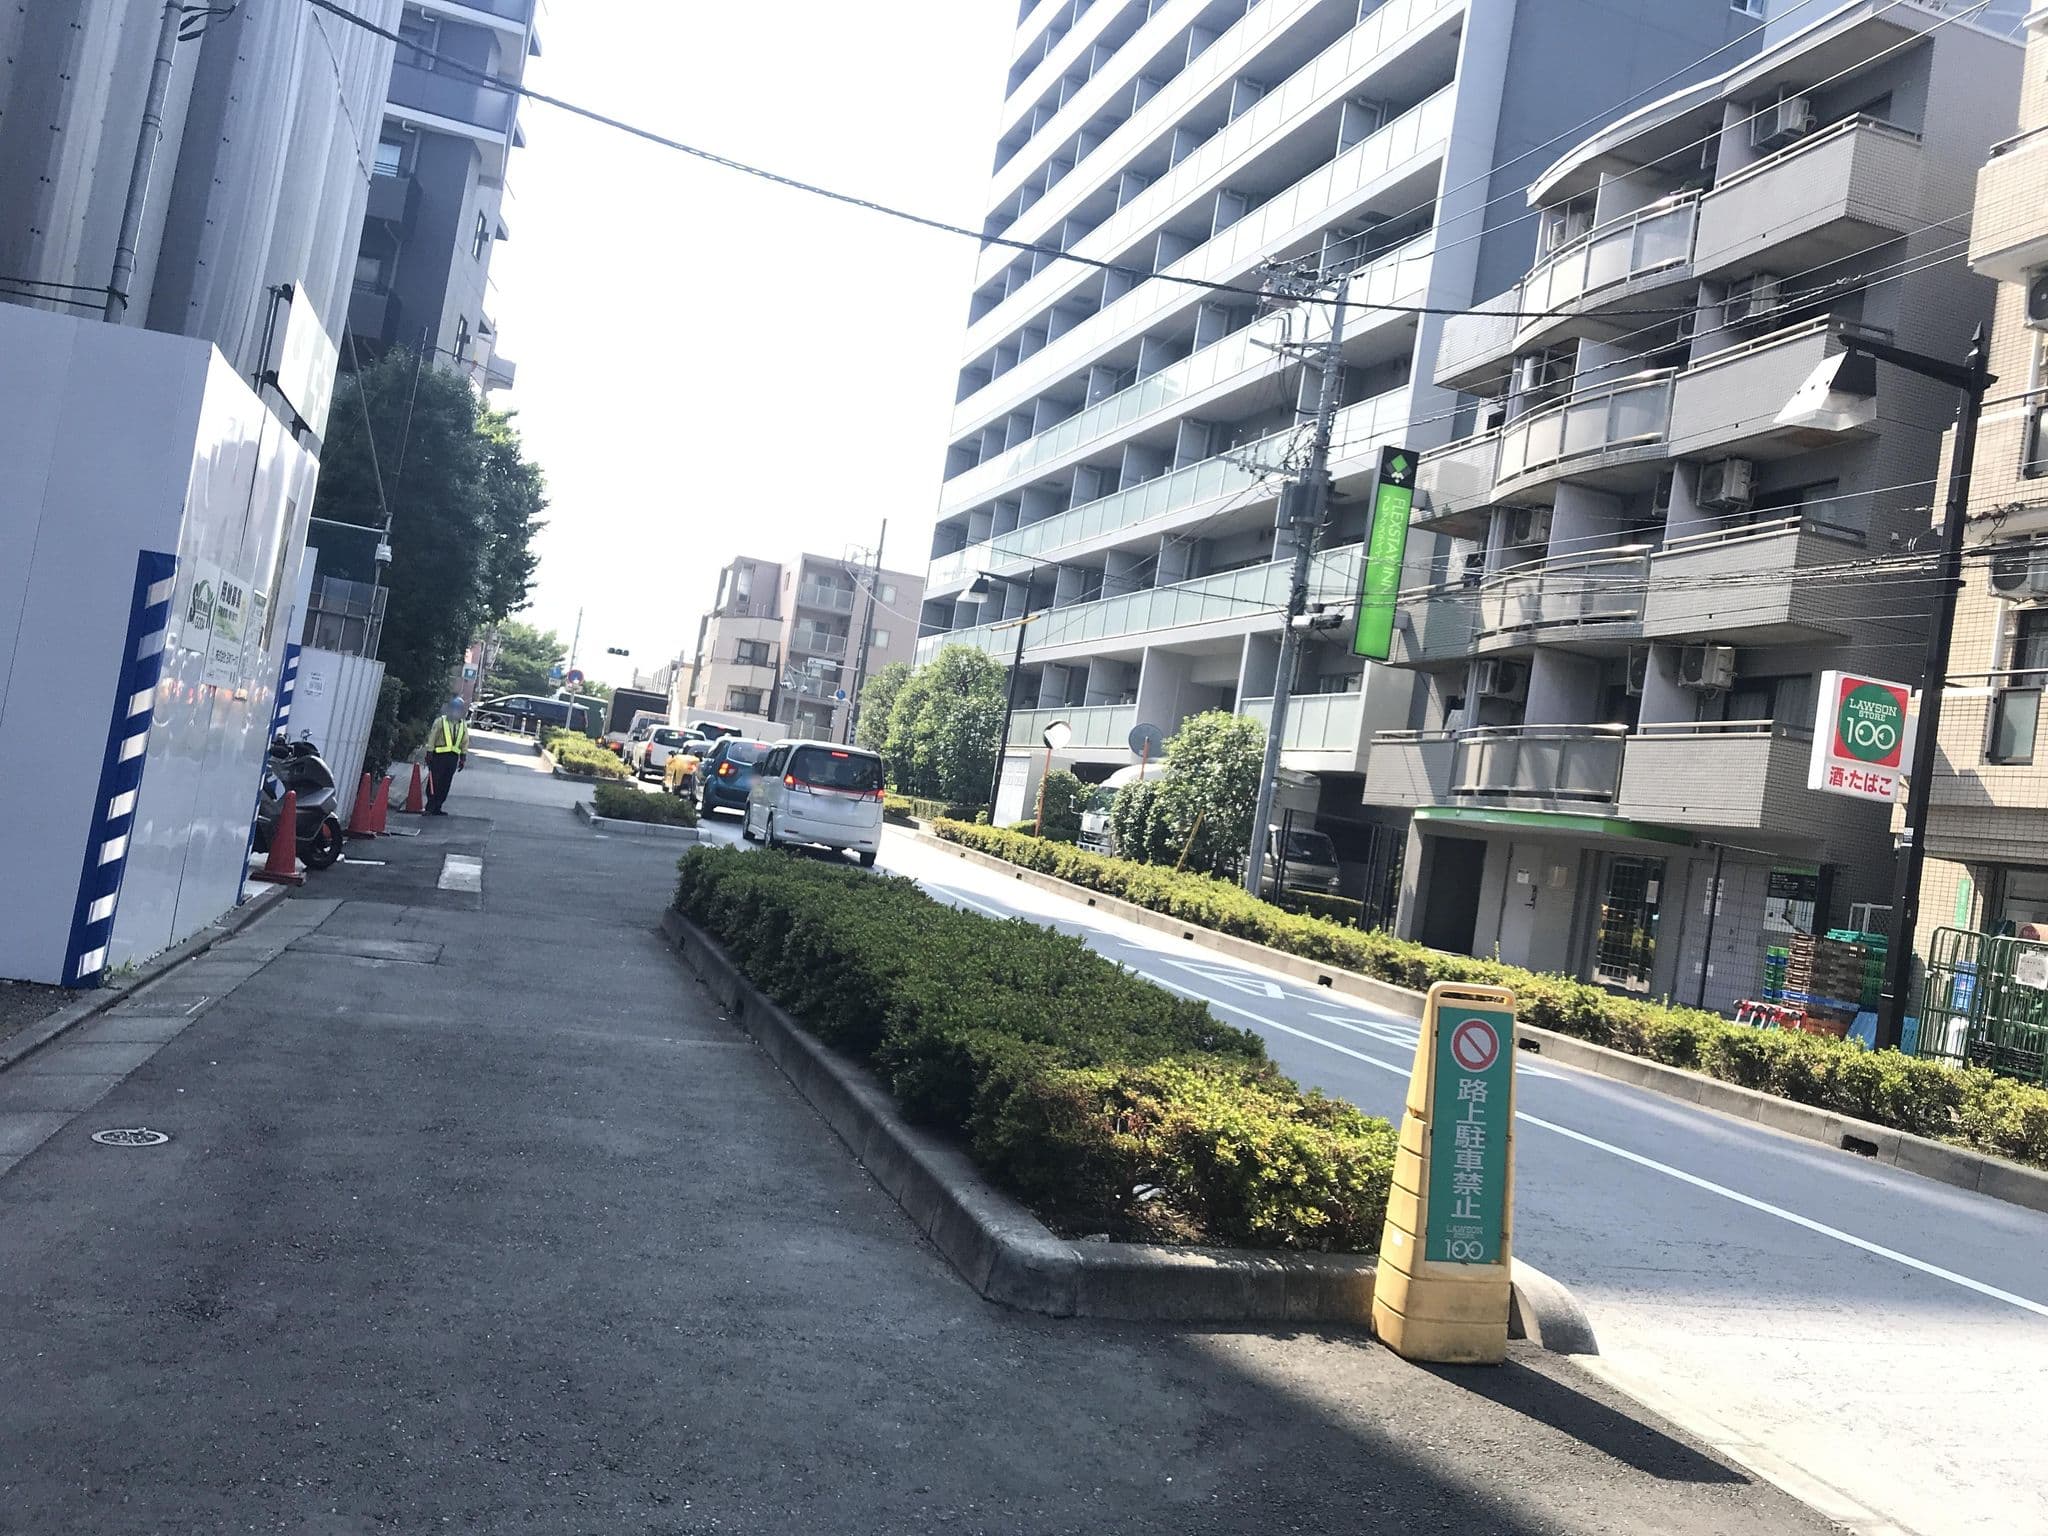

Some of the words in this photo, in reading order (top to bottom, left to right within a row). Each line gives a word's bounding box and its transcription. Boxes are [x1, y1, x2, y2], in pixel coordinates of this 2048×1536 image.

[1386, 497, 1406, 564] FLEXSTAY
[1381, 566, 1395, 594] INN
[1849, 698, 1898, 717] LAWSON
[1858, 709, 1886, 722] STORE
[1846, 716, 1896, 750] 100
[1451, 1078, 1488, 1220] 路上駐車禁止
[1445, 1239, 1484, 1260] 100
